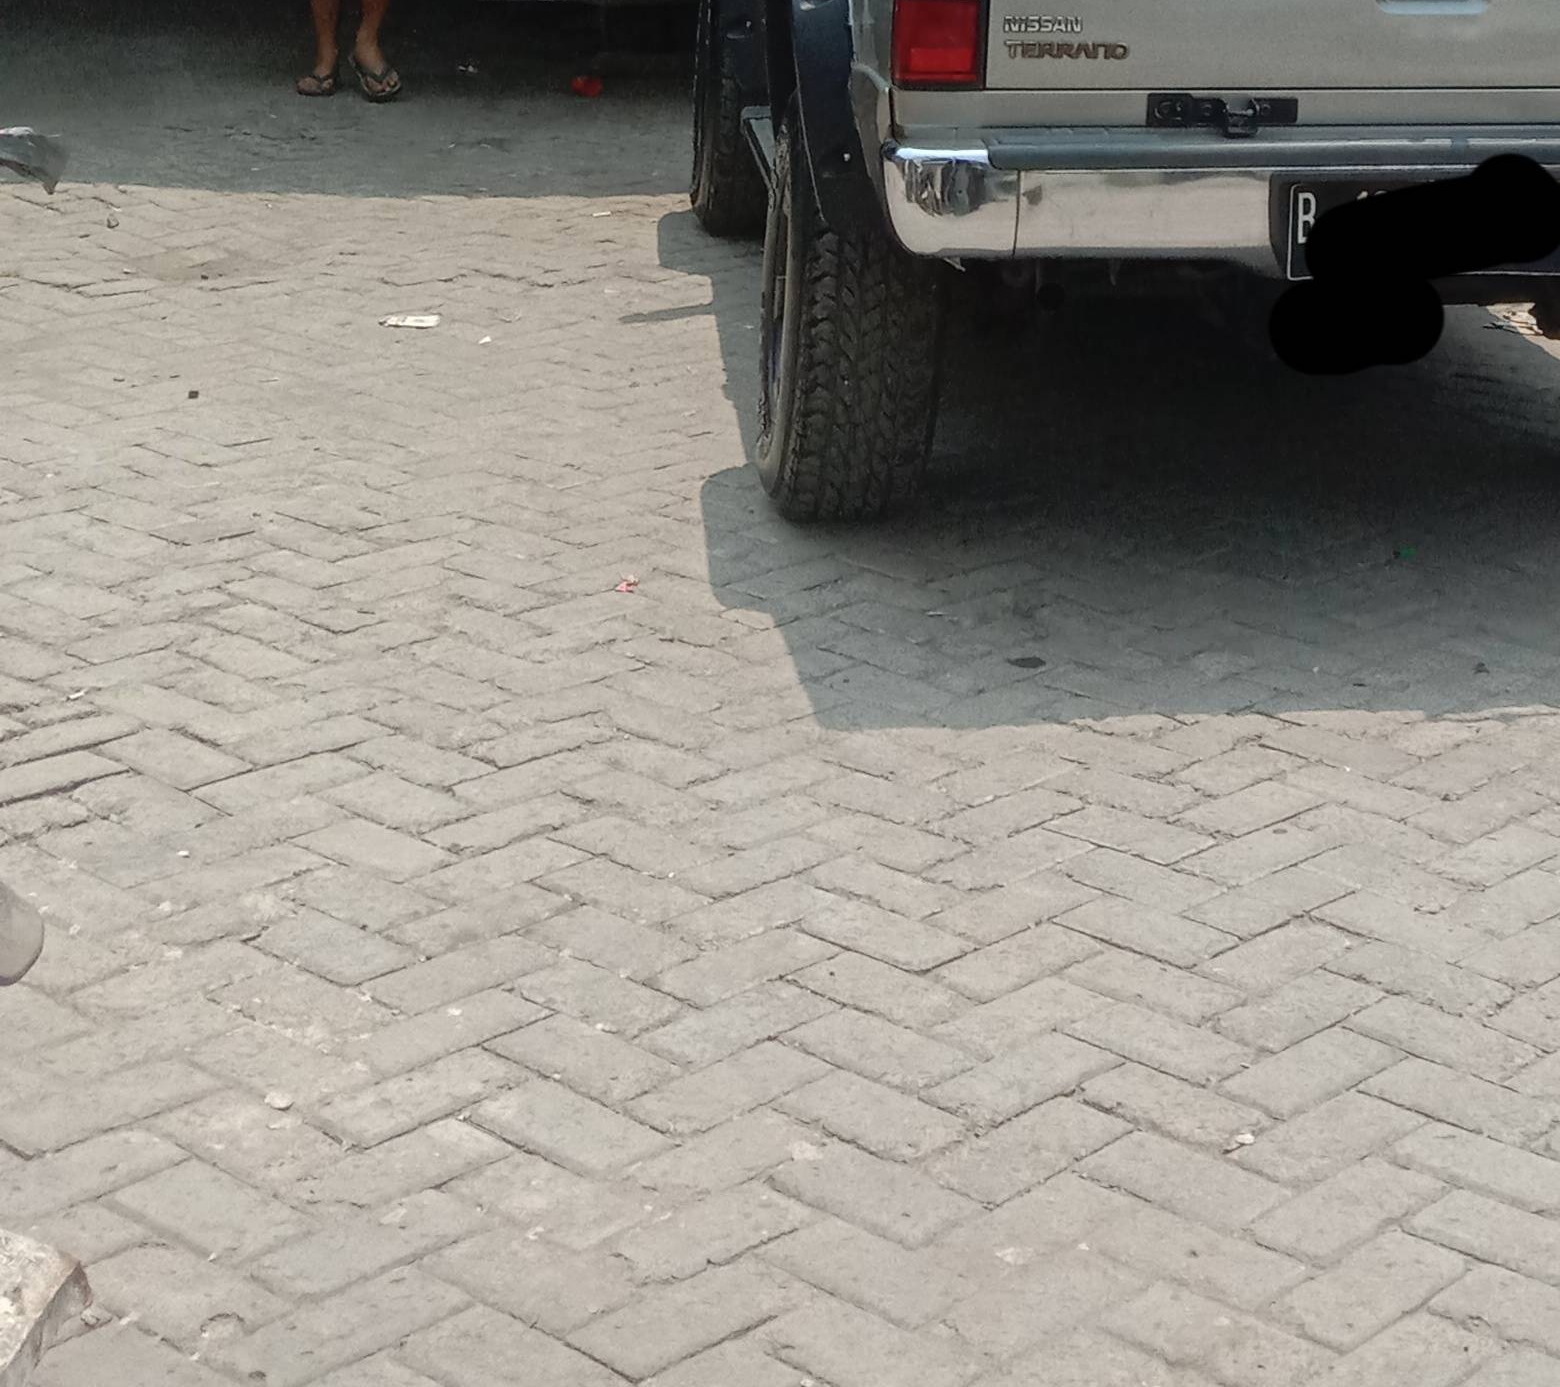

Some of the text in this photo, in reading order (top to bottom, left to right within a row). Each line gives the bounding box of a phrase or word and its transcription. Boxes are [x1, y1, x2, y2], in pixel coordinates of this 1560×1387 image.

[1004, 15, 1083, 33] NISSAN
[1004, 40, 1131, 60] TERRANO
[1297, 192, 1317, 244] B
